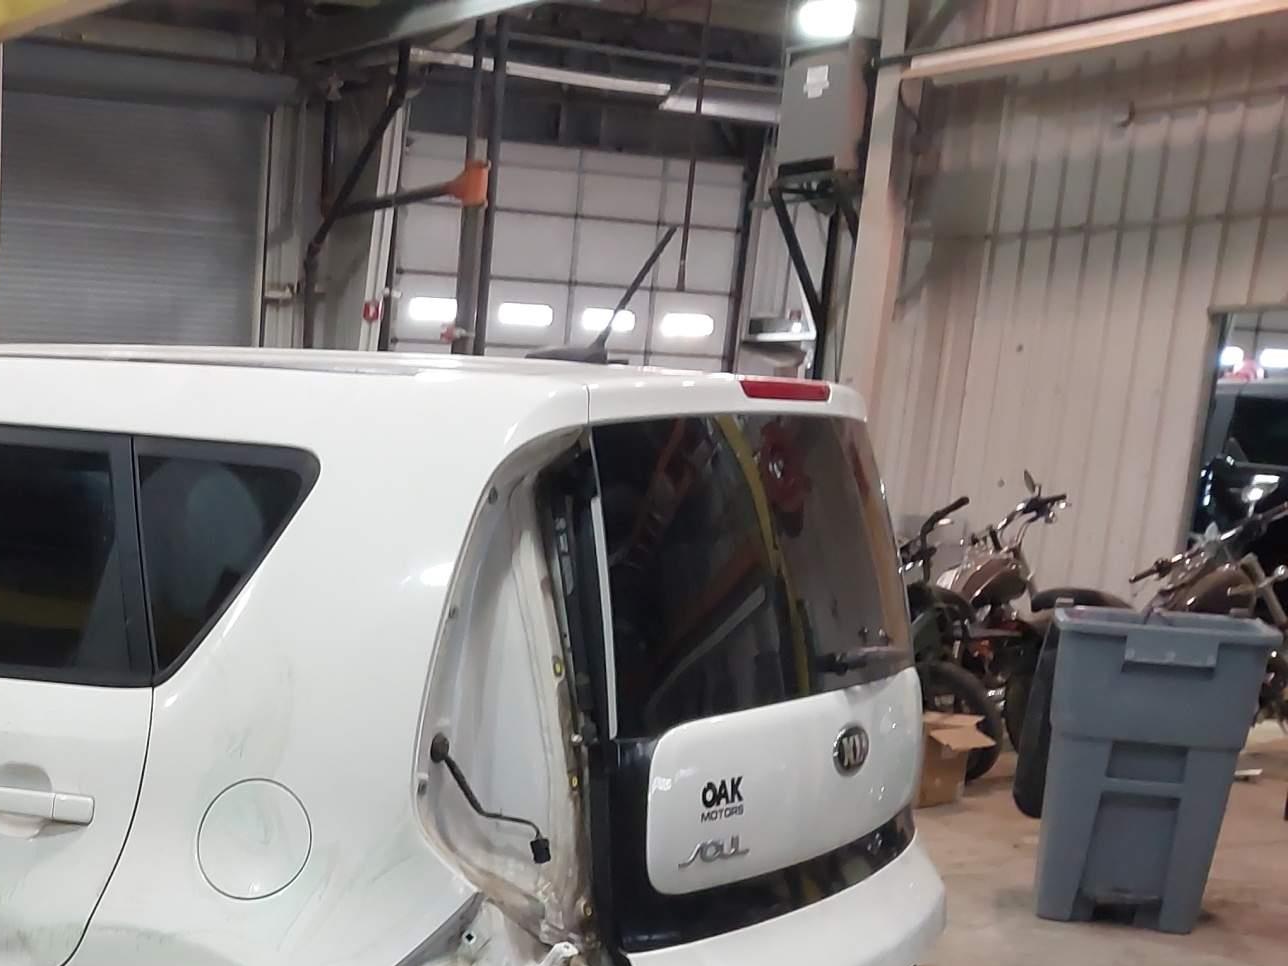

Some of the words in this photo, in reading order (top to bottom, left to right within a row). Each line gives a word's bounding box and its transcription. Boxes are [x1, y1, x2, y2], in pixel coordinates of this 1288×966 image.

[702, 776, 744, 809] OAK
[700, 804, 744, 824] MOTORS
[678, 835, 750, 869] SOUL
